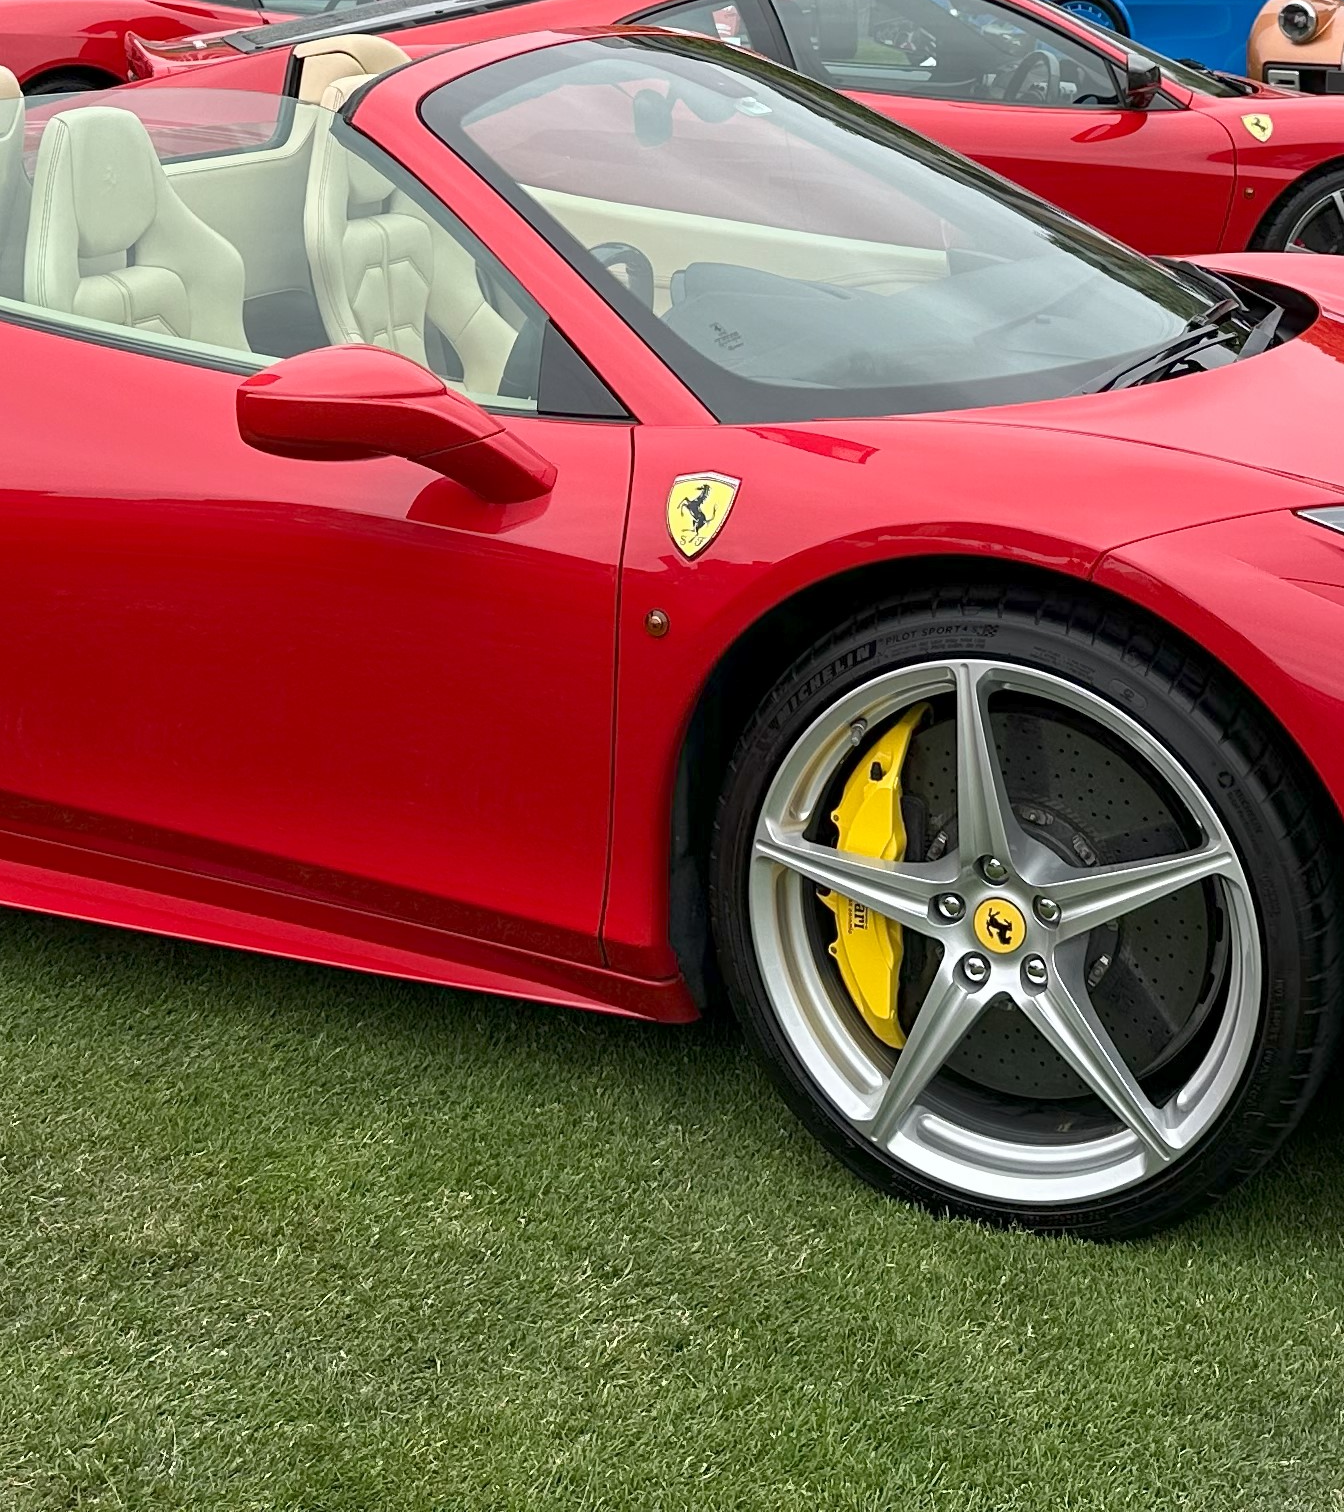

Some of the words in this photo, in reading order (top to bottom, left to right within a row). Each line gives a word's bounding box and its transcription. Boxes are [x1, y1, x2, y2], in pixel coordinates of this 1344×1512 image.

[885, 630, 917, 646] PILOT
[921, 625, 962, 637] SPORT
[777, 643, 872, 724] MICHELIN
